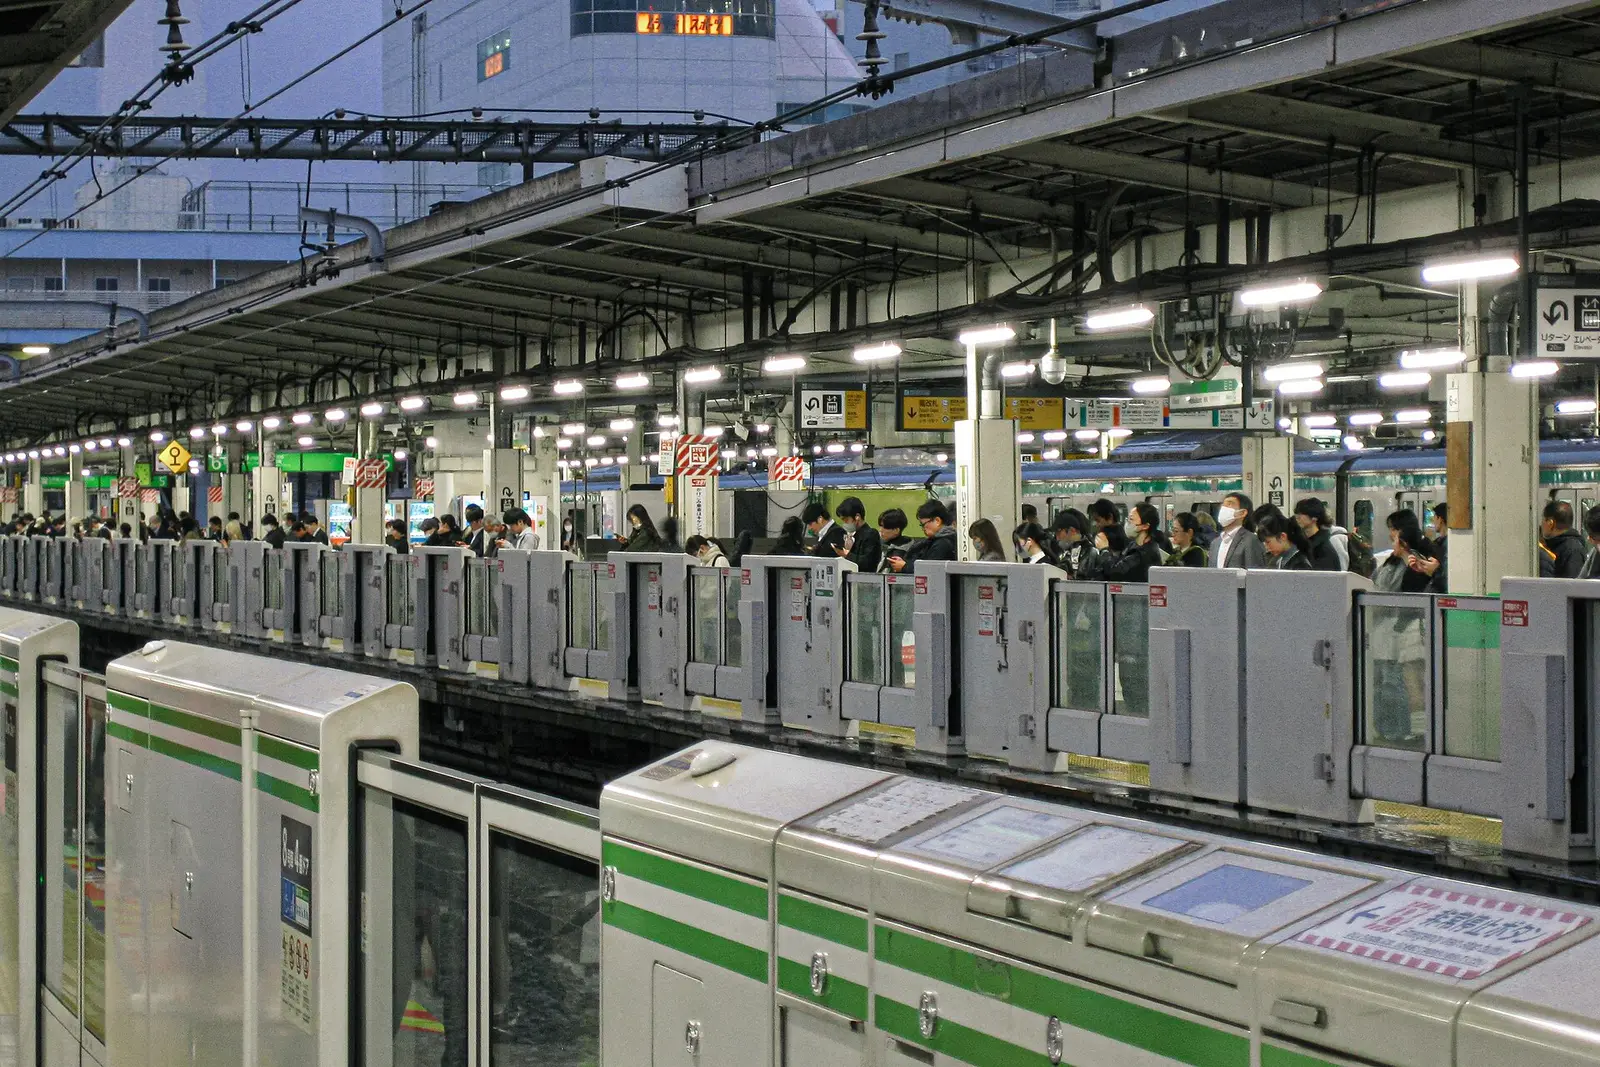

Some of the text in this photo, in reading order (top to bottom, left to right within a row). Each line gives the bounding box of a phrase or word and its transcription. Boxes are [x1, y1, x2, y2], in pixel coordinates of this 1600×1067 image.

[1541, 333, 1571, 342] Uターン
[1088, 400, 1095, 409] 4
[1121, 400, 1128, 409] 3
[1418, 908, 1549, 944] 非常停止ボタン
